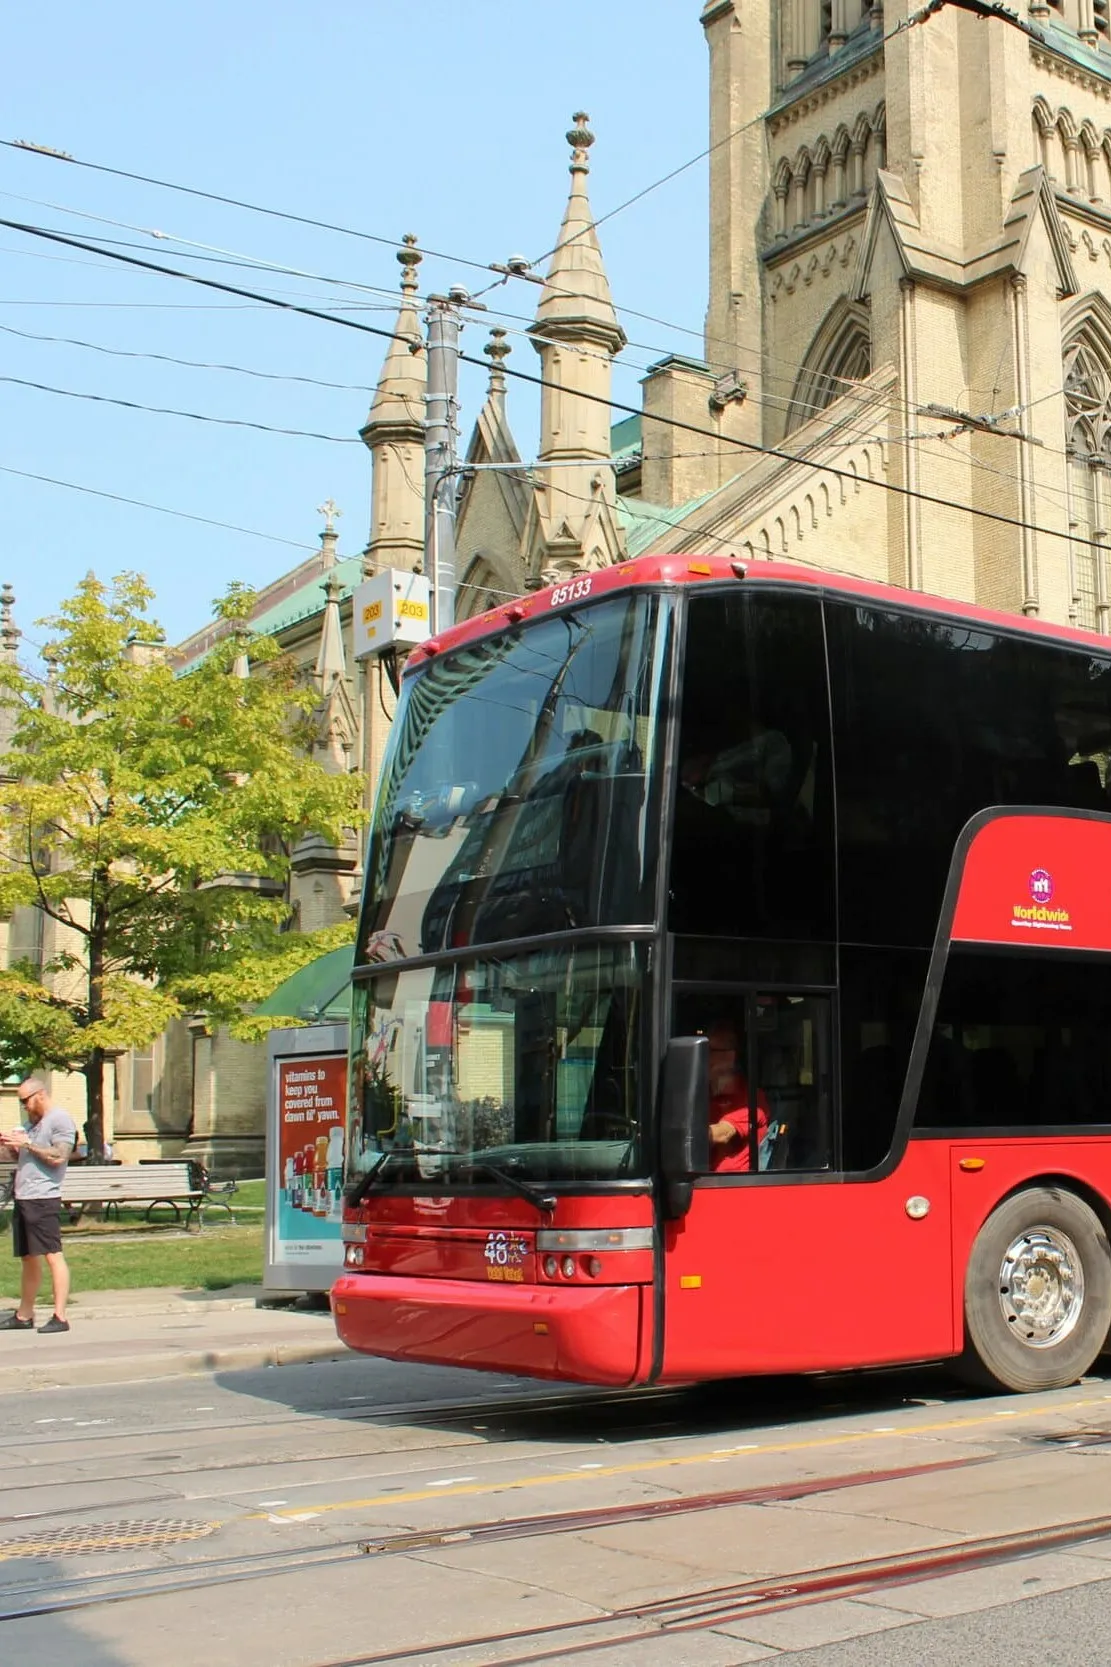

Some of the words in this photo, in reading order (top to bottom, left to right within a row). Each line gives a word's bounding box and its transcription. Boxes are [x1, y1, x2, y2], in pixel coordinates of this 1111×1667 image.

[551, 578, 592, 606] 85133
[365, 604, 380, 621] 203
[400, 602, 423, 617] 203
[285, 1070, 316, 1083] vitamins
[317, 1069, 326, 1080] to
[285, 1085, 303, 1097] keep
[303, 1084, 318, 1097] you
[285, 1096, 313, 1109] covered
[315, 1096, 333, 1107] from
[285, 1110, 305, 1123] dawn
